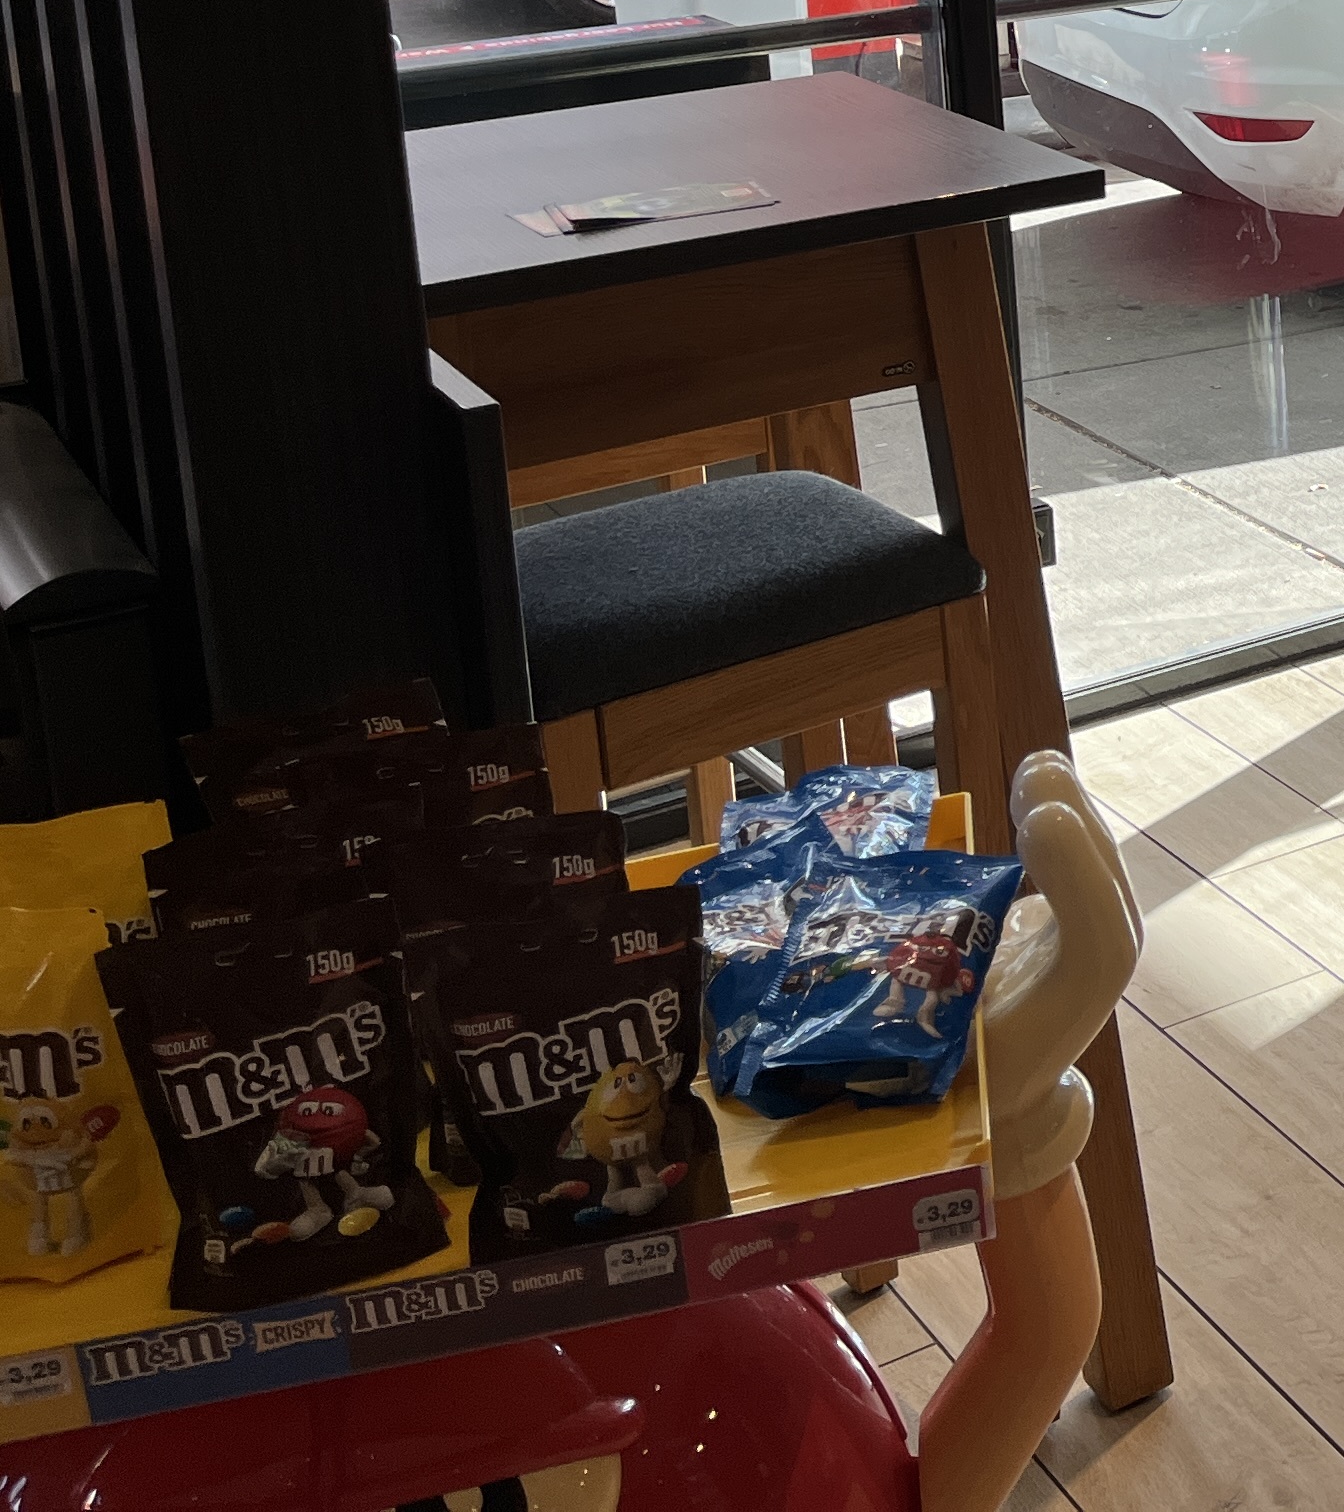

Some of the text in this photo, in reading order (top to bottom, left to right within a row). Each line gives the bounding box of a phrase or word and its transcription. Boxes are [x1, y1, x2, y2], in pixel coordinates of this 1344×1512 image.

[362, 714, 405, 736] 150g
[467, 762, 510, 787] 150g
[552, 854, 596, 880] 150g
[610, 930, 658, 959] 150g
[306, 949, 355, 979] 150g
[456, 988, 682, 1117] m&m's
[157, 1000, 386, 1141] m&m's
[927, 1198, 975, 1224] 3,29
[621, 1240, 671, 1267] 3,29
[348, 1266, 585, 1334] m&m's CHOCOLATE
[87, 1316, 328, 1388] m&m's CRISPY
[9, 1360, 62, 1385] 3,29
